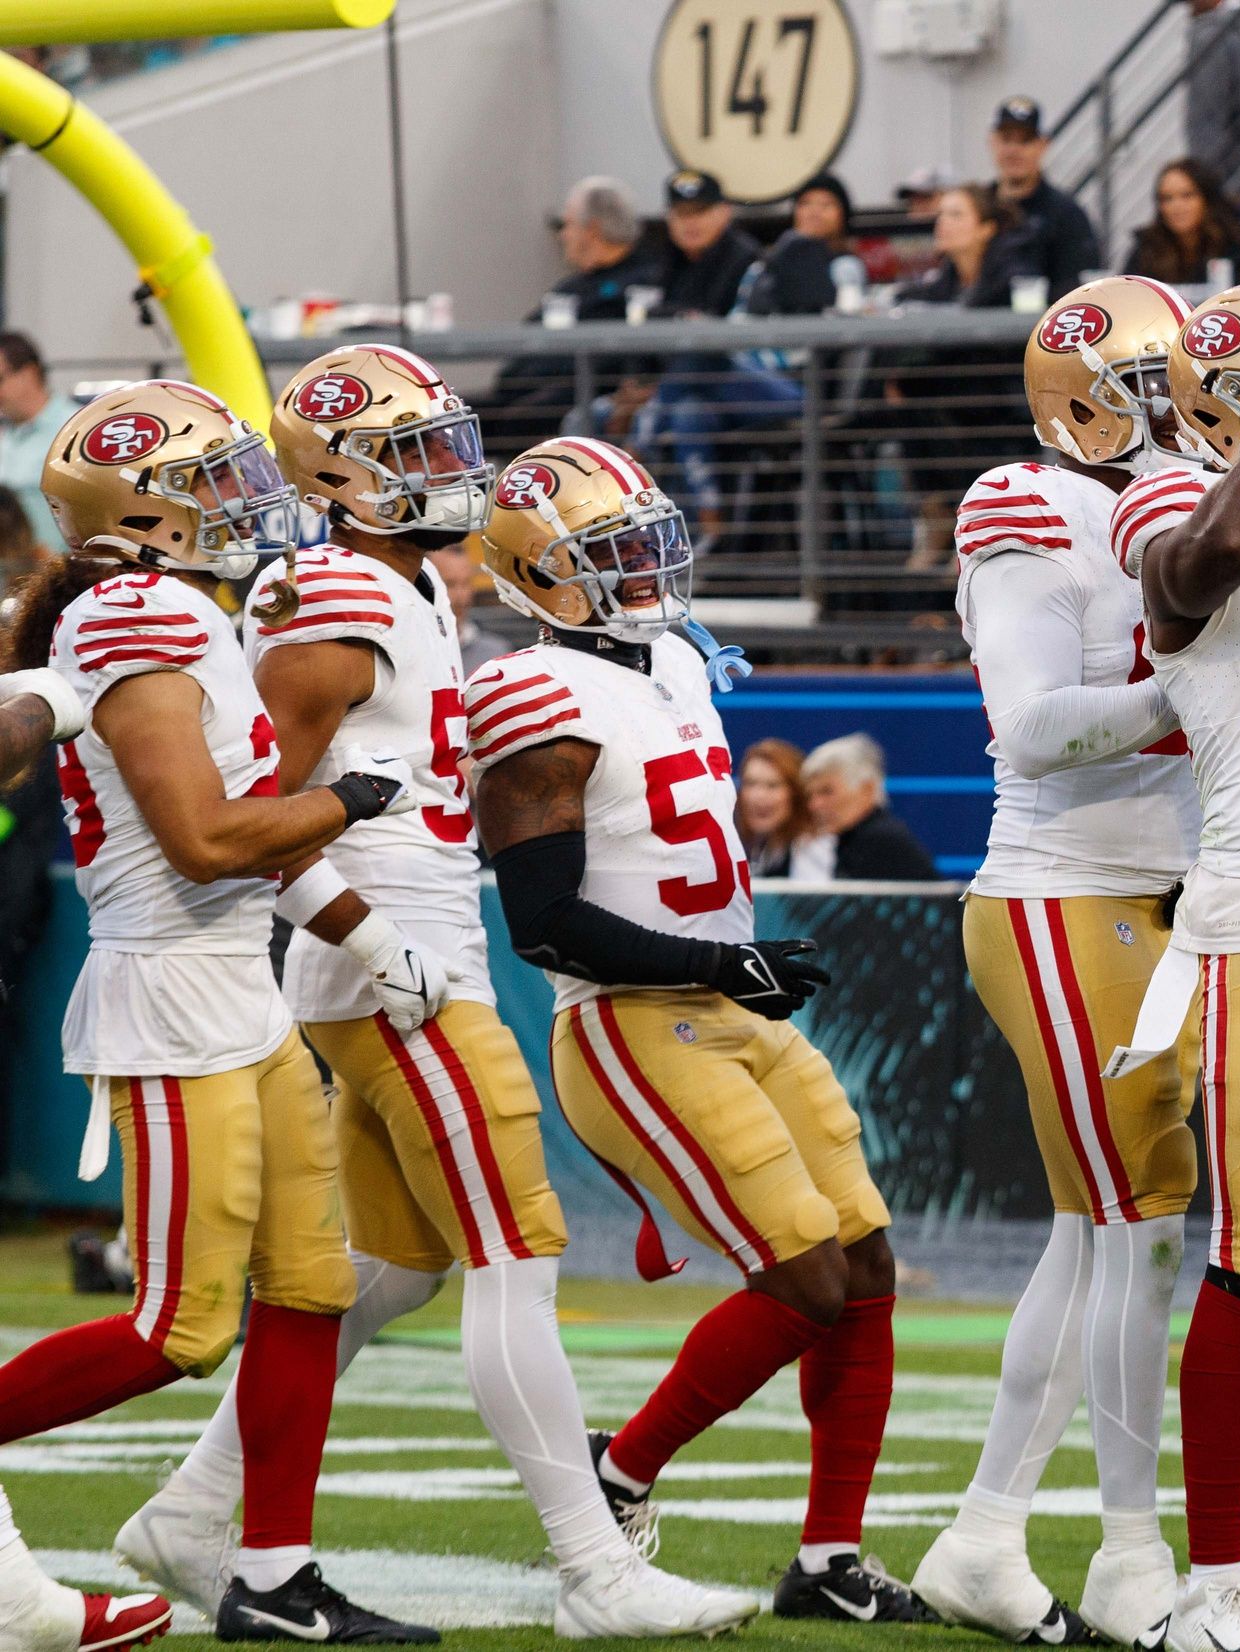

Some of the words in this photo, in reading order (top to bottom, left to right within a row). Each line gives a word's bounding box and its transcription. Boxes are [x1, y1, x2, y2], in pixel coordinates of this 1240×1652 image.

[694, 18, 816, 138] 147
[1193, 314, 1234, 354] SF
[310, 378, 356, 417] SF
[101, 417, 153, 460] SF
